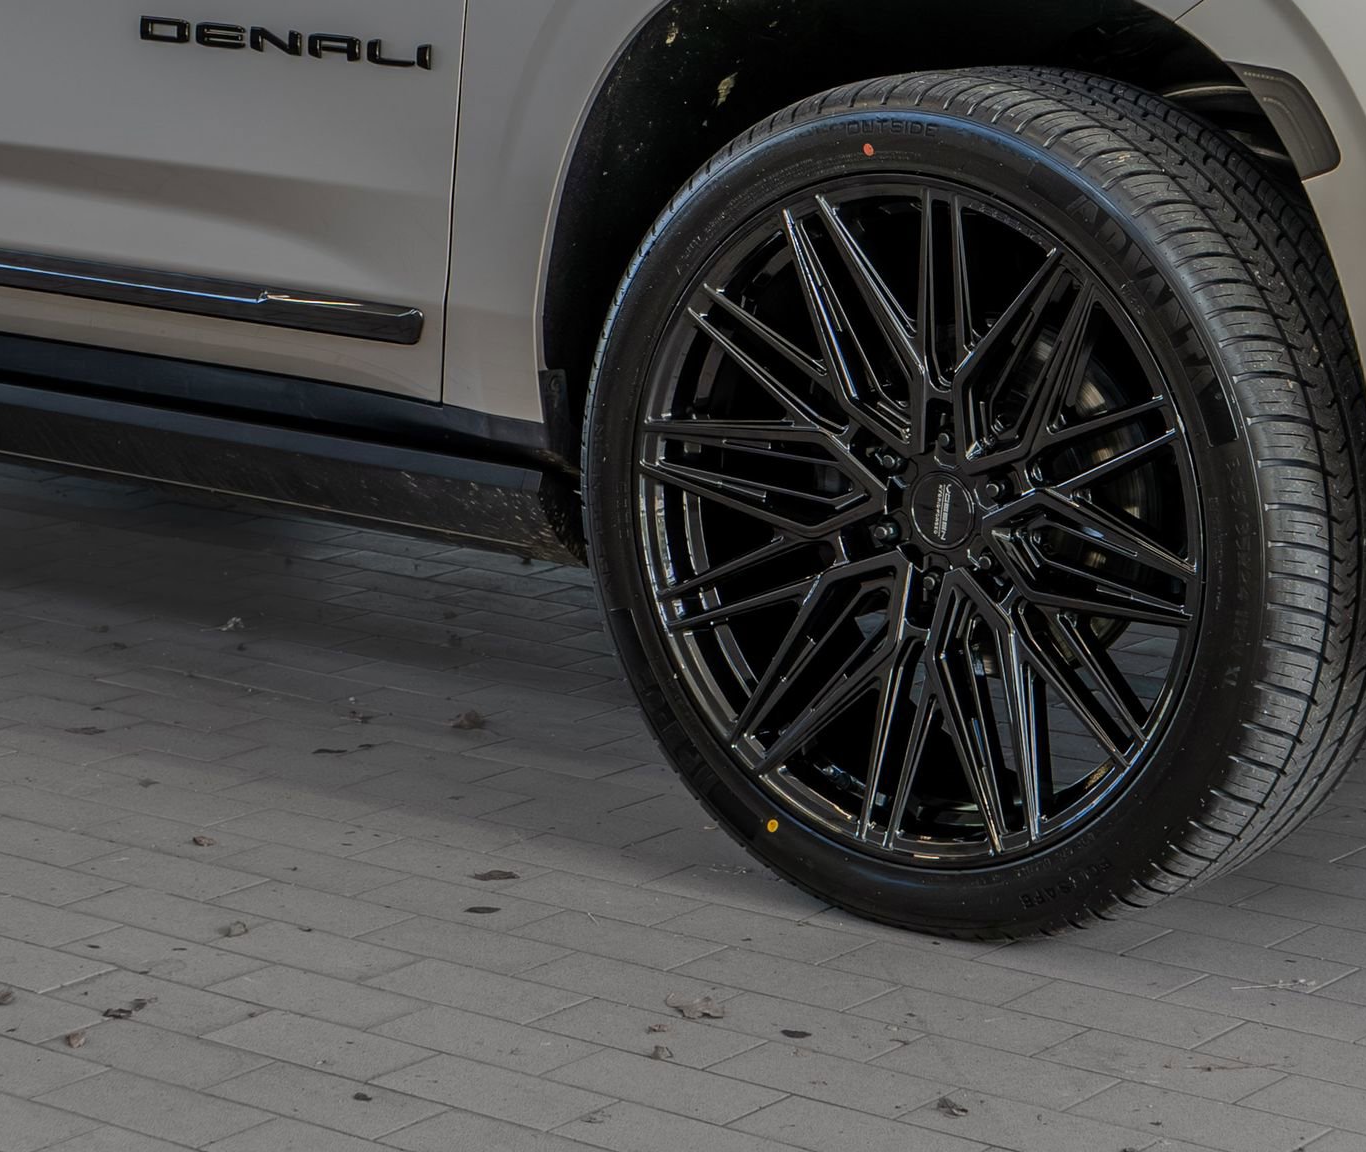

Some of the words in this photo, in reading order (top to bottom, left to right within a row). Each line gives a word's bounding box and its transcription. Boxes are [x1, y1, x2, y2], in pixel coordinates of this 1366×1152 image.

[139, 15, 432, 70] DENALI
[846, 116, 939, 138] OUTSIDE
[940, 483, 952, 541] VOSSEN
